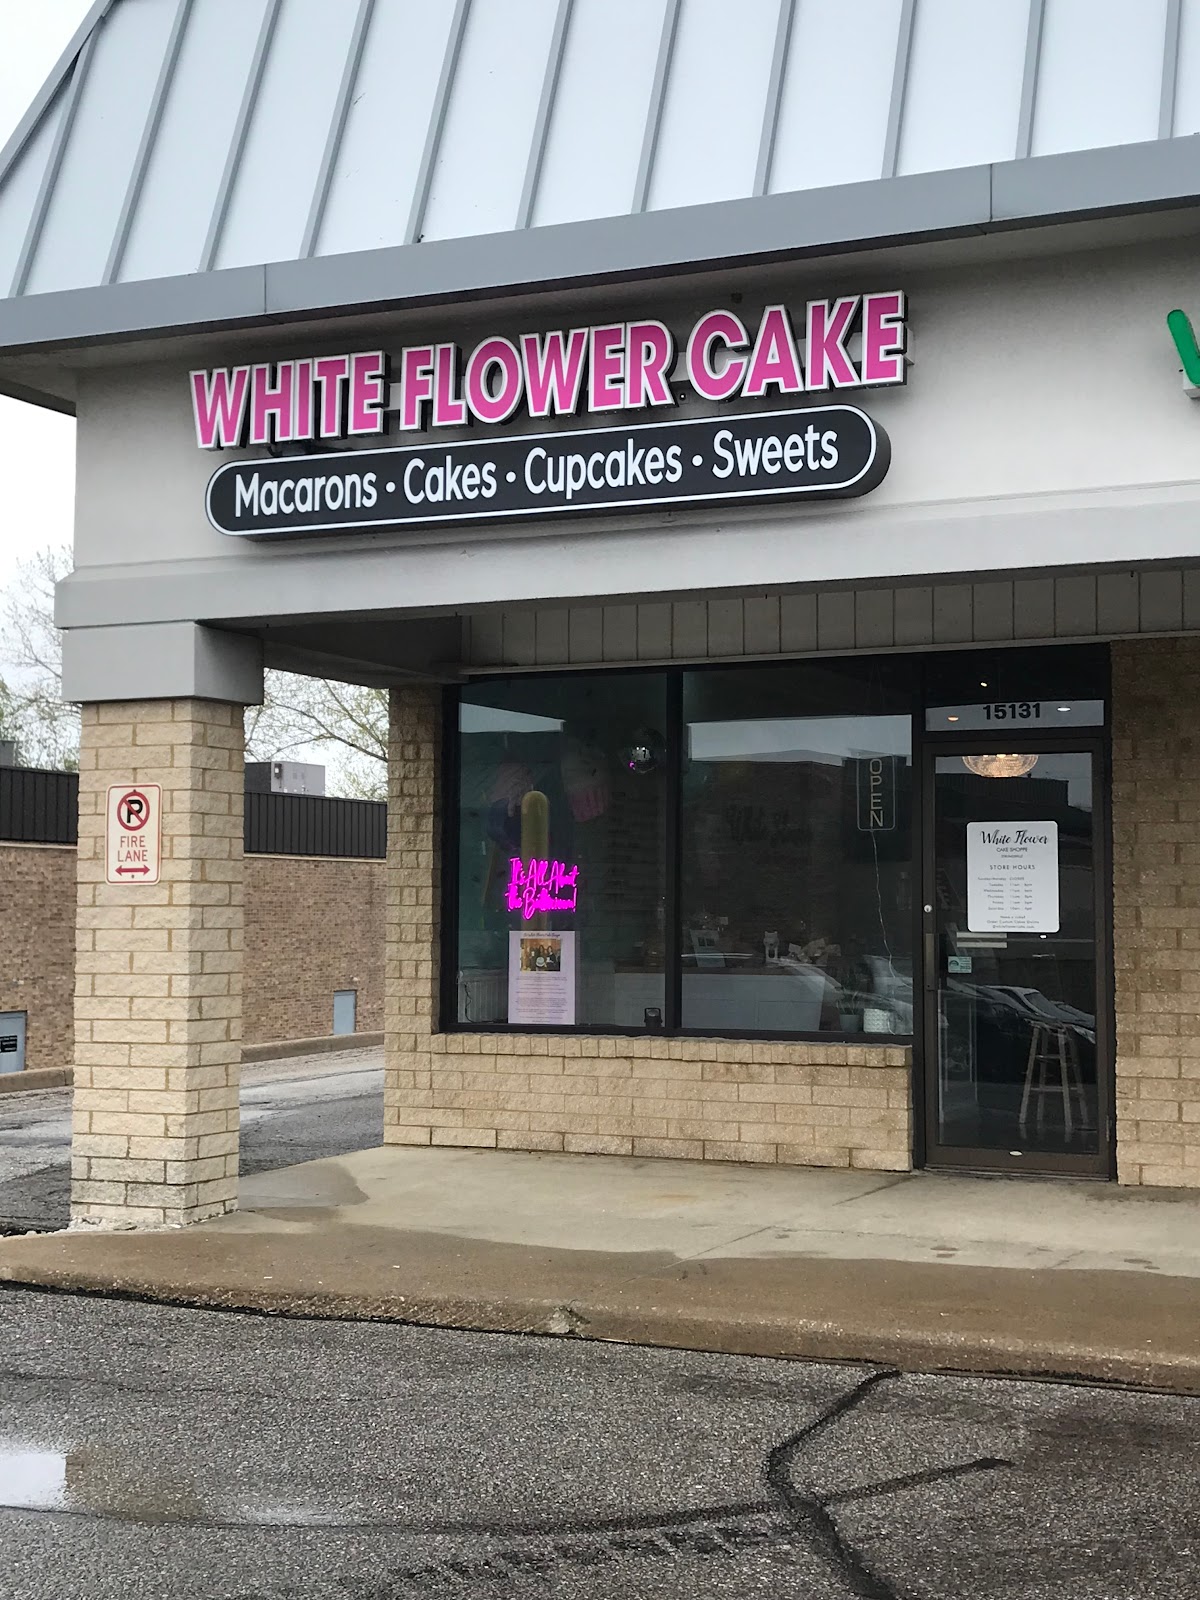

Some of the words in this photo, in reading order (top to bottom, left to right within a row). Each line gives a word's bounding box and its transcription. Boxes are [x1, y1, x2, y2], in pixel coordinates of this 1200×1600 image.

[189, 350, 388, 450] WHITE
[399, 319, 674, 430] FLOWER
[686, 290, 906, 401] CAKE
[234, 471, 378, 518] Macarons
[403, 455, 498, 504] Cakes
[524, 438, 683, 500] Cupcakes
[711, 424, 839, 479] Sweets
[983, 702, 1041, 720] 15131
[869, 758, 884, 828] OPEN
[120, 835, 146, 848] FIRE
[981, 829, 1011, 845] White
[1014, 829, 1048, 845] Flower
[117, 849, 148, 862] LANE
